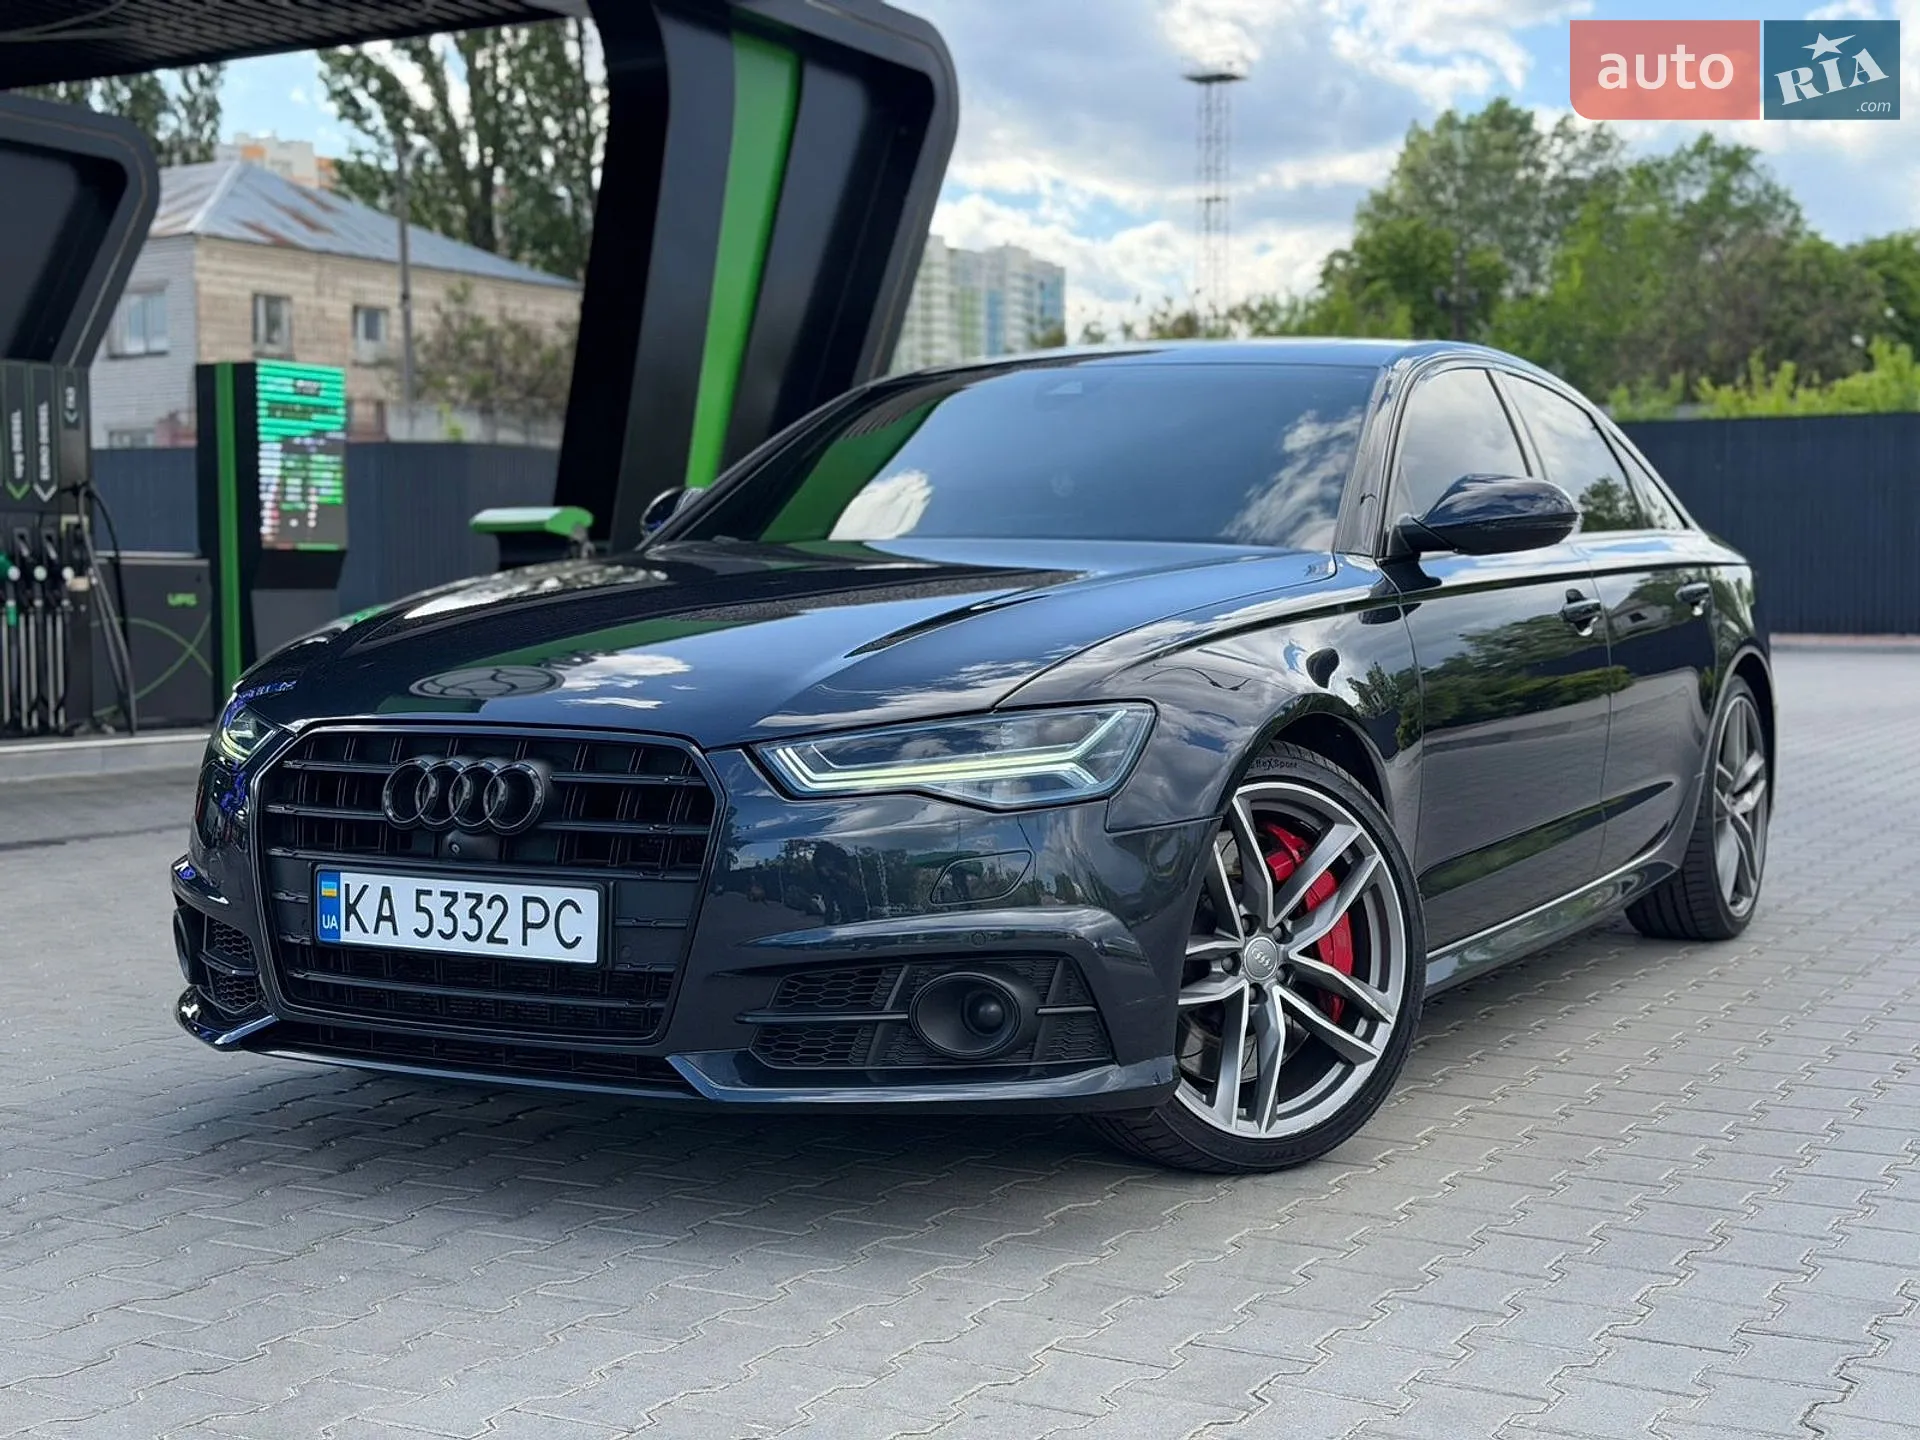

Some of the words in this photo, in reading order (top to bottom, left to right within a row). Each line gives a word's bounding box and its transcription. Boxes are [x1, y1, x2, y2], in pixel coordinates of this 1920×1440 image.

[322, 914, 338, 930] UA
[344, 883, 399, 937] KA
[413, 889, 509, 945] 5332
[521, 895, 583, 950] PC
